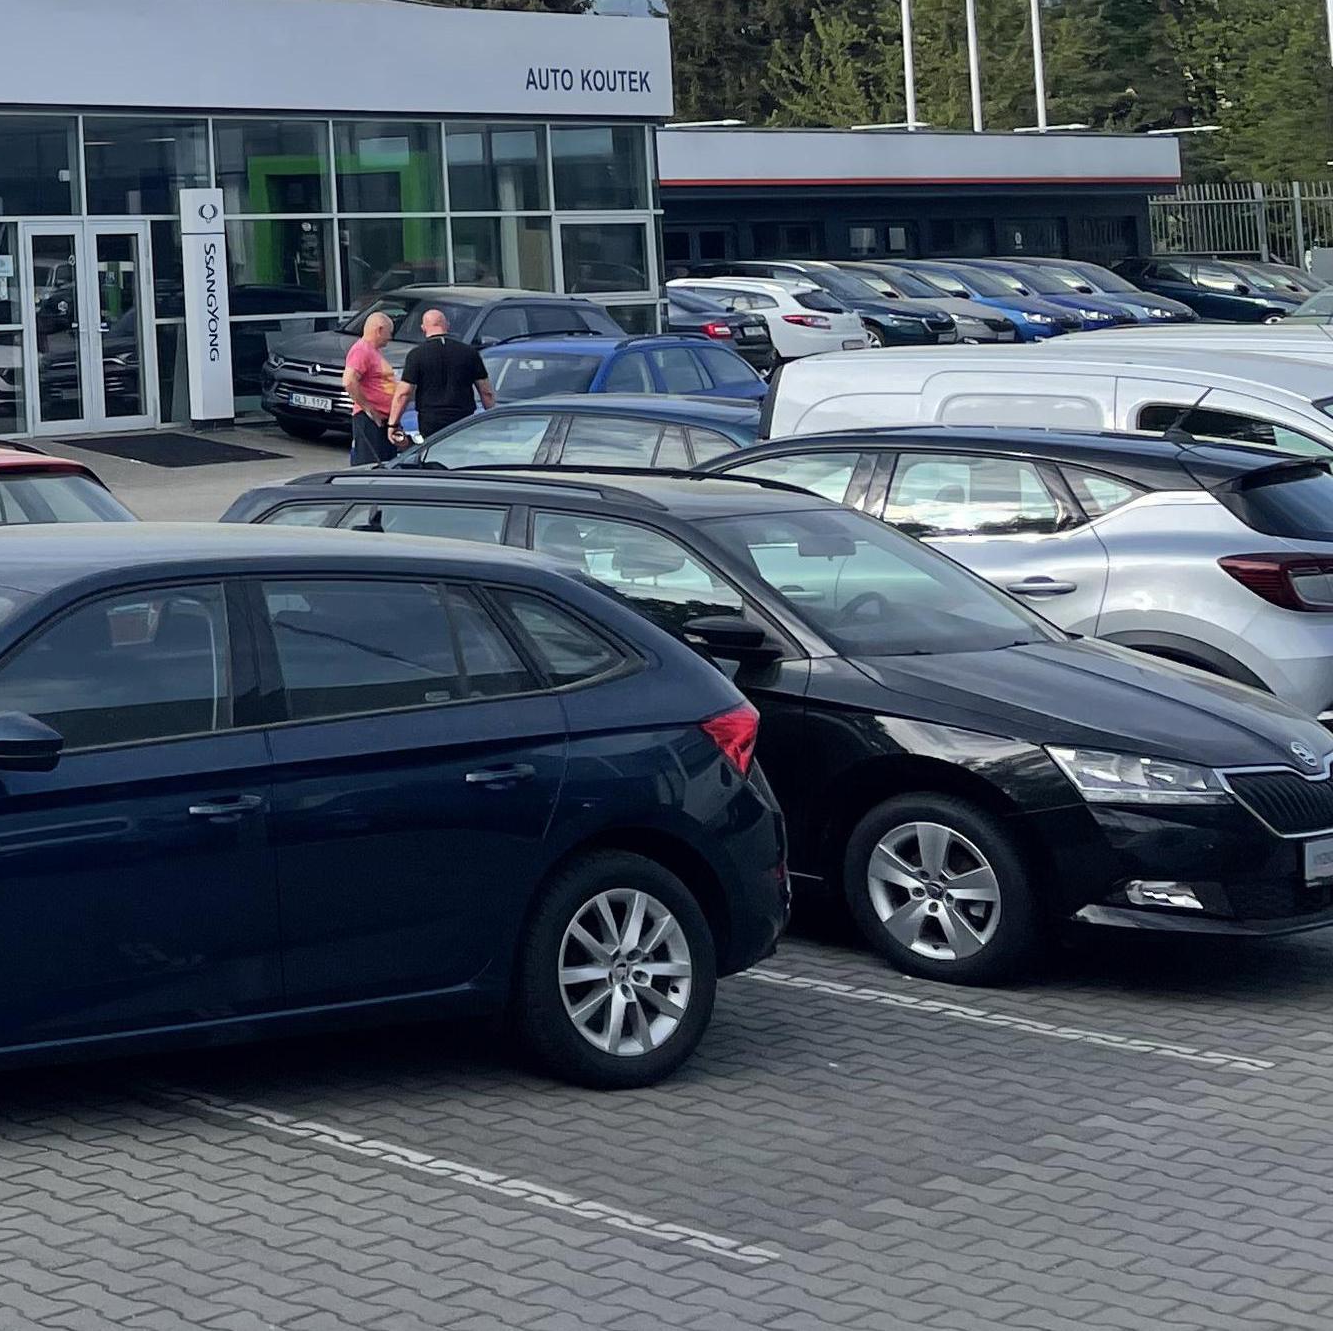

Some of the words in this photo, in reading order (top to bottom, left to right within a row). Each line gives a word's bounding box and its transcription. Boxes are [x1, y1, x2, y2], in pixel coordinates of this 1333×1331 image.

[525, 67, 574, 91] AUTO
[580, 68, 651, 92] KOUTEK
[204, 243, 220, 362] SSANGYONG
